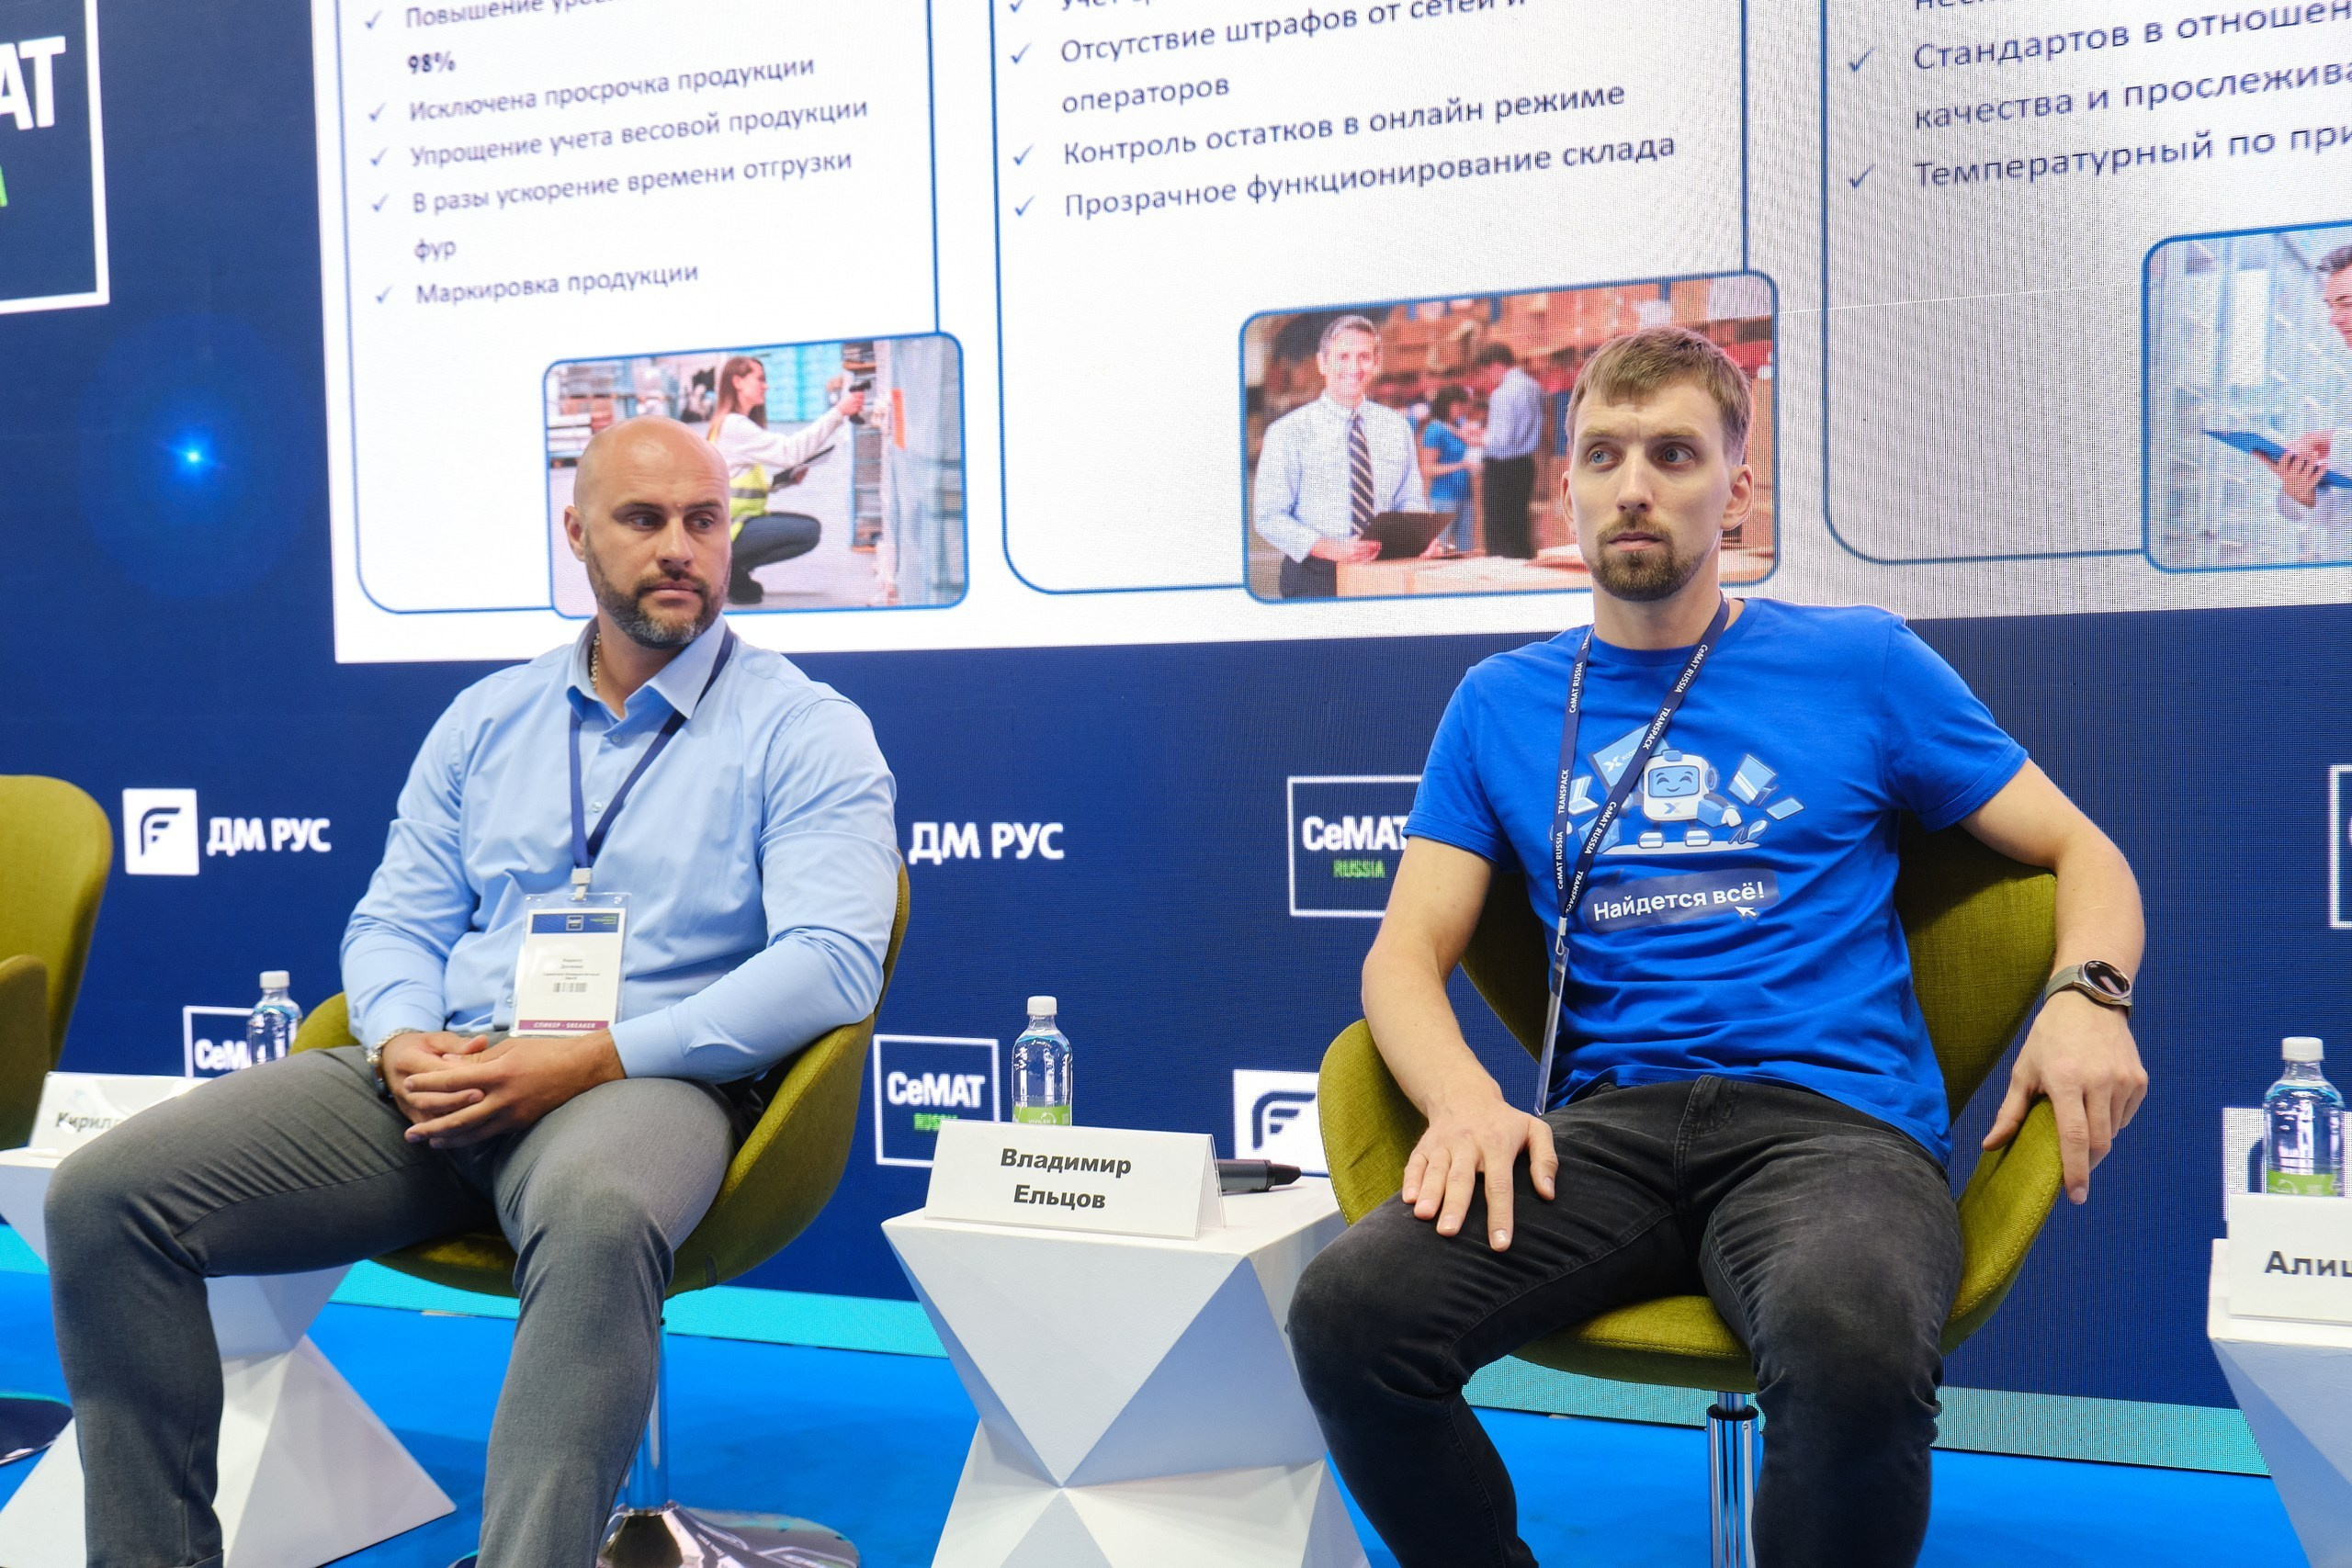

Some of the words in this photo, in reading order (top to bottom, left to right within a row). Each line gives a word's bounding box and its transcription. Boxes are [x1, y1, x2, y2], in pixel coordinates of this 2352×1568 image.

[406, 0, 544, 28] Повышение
[1061, 28, 1216, 63] Отсутствие
[1227, 8, 1358, 43] штрафов
[1368, 2, 1401, 24] от
[408, 51, 456, 74] 98%
[1914, 26, 2130, 70] Стандартов
[2144, 21, 2164, 43] в
[410, 93, 537, 121] Исключена
[545, 75, 670, 109] просрочка
[678, 59, 815, 93] продукции
[1062, 77, 1229, 113] операторов
[1916, 92, 2073, 130] качества
[2088, 88, 2109, 110] и
[411, 137, 543, 168] Упрощение
[550, 130, 613, 157] учета
[621, 111, 720, 144] весовой
[729, 101, 868, 134] продукции
[1065, 136, 1196, 164] Контроль
[1206, 119, 1333, 151] остатков
[1344, 117, 1360, 136] в
[1370, 97, 1483, 132] онлайн
[1495, 85, 1625, 124] режиме
[1914, 129, 2214, 187] Температурный
[2229, 133, 2277, 156] по
[413, 192, 426, 213] В
[434, 191, 490, 216] разы
[496, 177, 620, 209] ускорение
[627, 164, 735, 195] времени
[743, 152, 853, 182] отгрузки
[1066, 183, 1237, 220] Прозрачное
[1247, 149, 1553, 204] функционирование
[1562, 136, 1676, 167] склада
[413, 238, 458, 264] фур
[416, 276, 560, 306] Маркировка
[567, 265, 699, 295] продукции
[1573, 661, 1584, 687] RUSSIA
[1686, 644, 1709, 671] CeMAT
[1674, 668, 1695, 694] RUSSIA
[1568, 688, 1579, 714] CeMAT
[1642, 706, 1671, 750] TRANSPACK
[1557, 769, 1569, 815] TRANSPACK
[1302, 814, 1409, 852] CeMAT
[1599, 801, 1617, 829] CeMAT
[207, 816, 267, 858] ДМ
[270, 817, 333, 853] РУС
[908, 821, 982, 866] ДМ
[990, 821, 1066, 861] РУС
[1555, 831, 1564, 860] RUSSIA
[1584, 827, 1603, 855] RUSSIA
[1593, 891, 1708, 922] Найдется
[1713, 881, 1765, 904] всё!
[887, 1071, 986, 1109] CeMAT
[1001, 1147, 1132, 1179] Владимир
[1013, 1184, 1106, 1211] Ельцов
